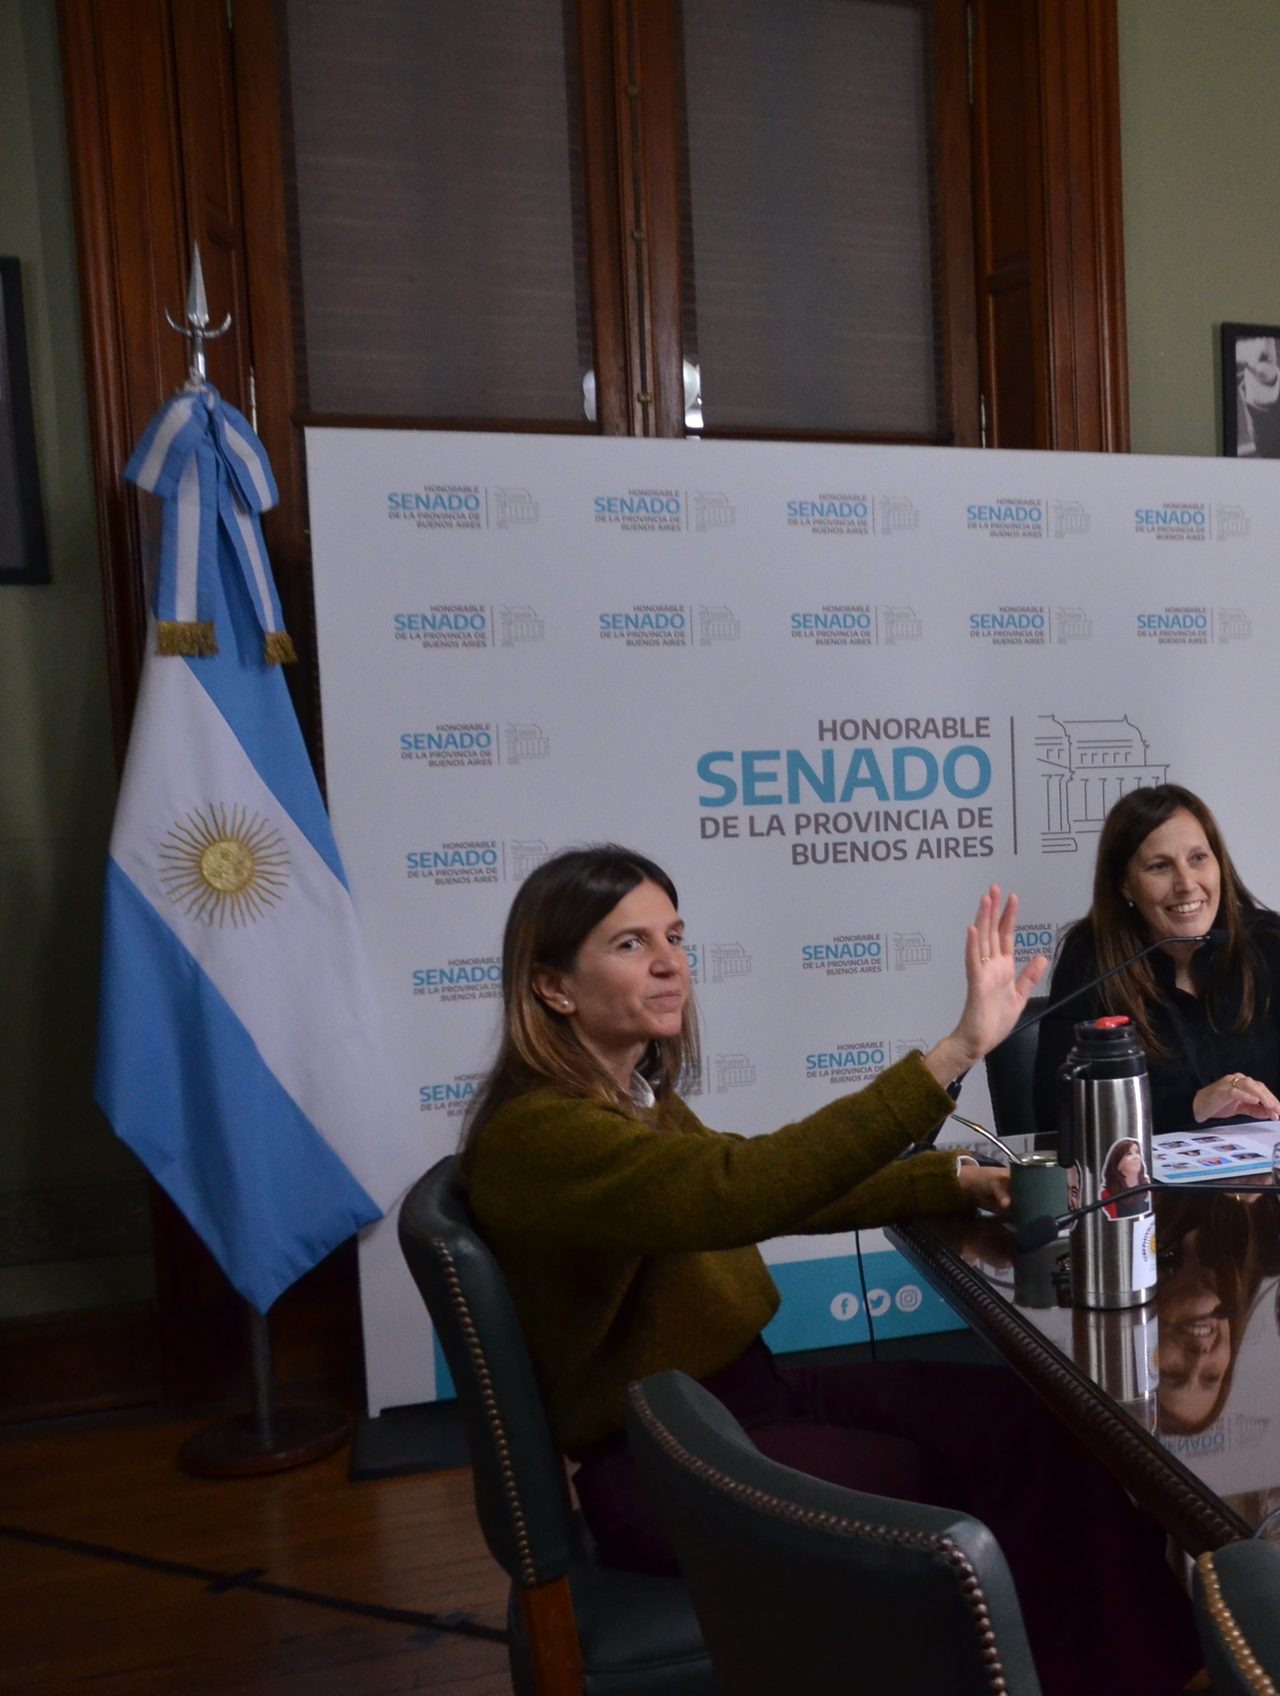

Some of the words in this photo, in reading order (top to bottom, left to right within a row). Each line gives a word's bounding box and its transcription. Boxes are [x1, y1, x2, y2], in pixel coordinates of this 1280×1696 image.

[424, 485, 479, 493] HONORABLE
[629, 489, 680, 497] HONORABLE
[387, 492, 480, 512] SENADO
[593, 496, 680, 515] SENADO
[786, 500, 867, 519] SENADO
[966, 505, 1042, 523] SENADO
[417, 512, 466, 520] PROVINCIA
[622, 515, 668, 523] PROVINCIA
[1134, 509, 1205, 526] SENADO
[455, 521, 481, 529] AIRES
[430, 605, 485, 613] HONORABLE
[823, 605, 870, 613] HONORABLE
[393, 613, 485, 631] SENADO
[598, 613, 685, 630] SENADO
[790, 613, 870, 629] SENADO
[969, 613, 1044, 629] SENADO
[1136, 614, 1207, 629] SENADO
[423, 632, 472, 640] PROVINCIA
[614, 631, 625, 639] LA
[461, 640, 486, 648] AIRES
[626, 639, 661, 647] BUENOS
[437, 724, 491, 732] HONORABLE
[819, 717, 991, 742] HONORABLE
[399, 732, 491, 751] SENADO
[400, 752, 413, 760] DE
[429, 750, 478, 759] PROVINCIA
[429, 759, 465, 768] BUENOS
[467, 758, 492, 766] AIRES
[697, 745, 992, 808] SENADO
[700, 816, 740, 840] DE
[749, 815, 786, 838] LA
[795, 809, 949, 836] PROVINCIA
[957, 807, 994, 831] DE
[443, 841, 496, 850] HONORABLE
[791, 840, 908, 867] BUENOS
[916, 836, 994, 861] AIRES
[405, 849, 497, 869] SENADO
[422, 870, 434, 878] LA
[436, 868, 484, 877] PROVINCIA
[435, 877, 471, 886] BUENOS
[473, 875, 498, 883] AIRES
[833, 934, 880, 943] HONORABLE
[801, 941, 881, 961] SENADO
[802, 962, 813, 970] DE
[827, 959, 869, 968] PROVINCIA
[412, 965, 501, 986] SENADO
[826, 967, 858, 976] BUENOS
[860, 965, 881, 973] AIRES
[837, 1041, 884, 1051] HONORABLE
[805, 1049, 884, 1070] SENADO
[831, 1066, 873, 1076] PROVINCIA
[830, 1075, 862, 1084] BUENOS
[419, 1083, 475, 1102] SENA
